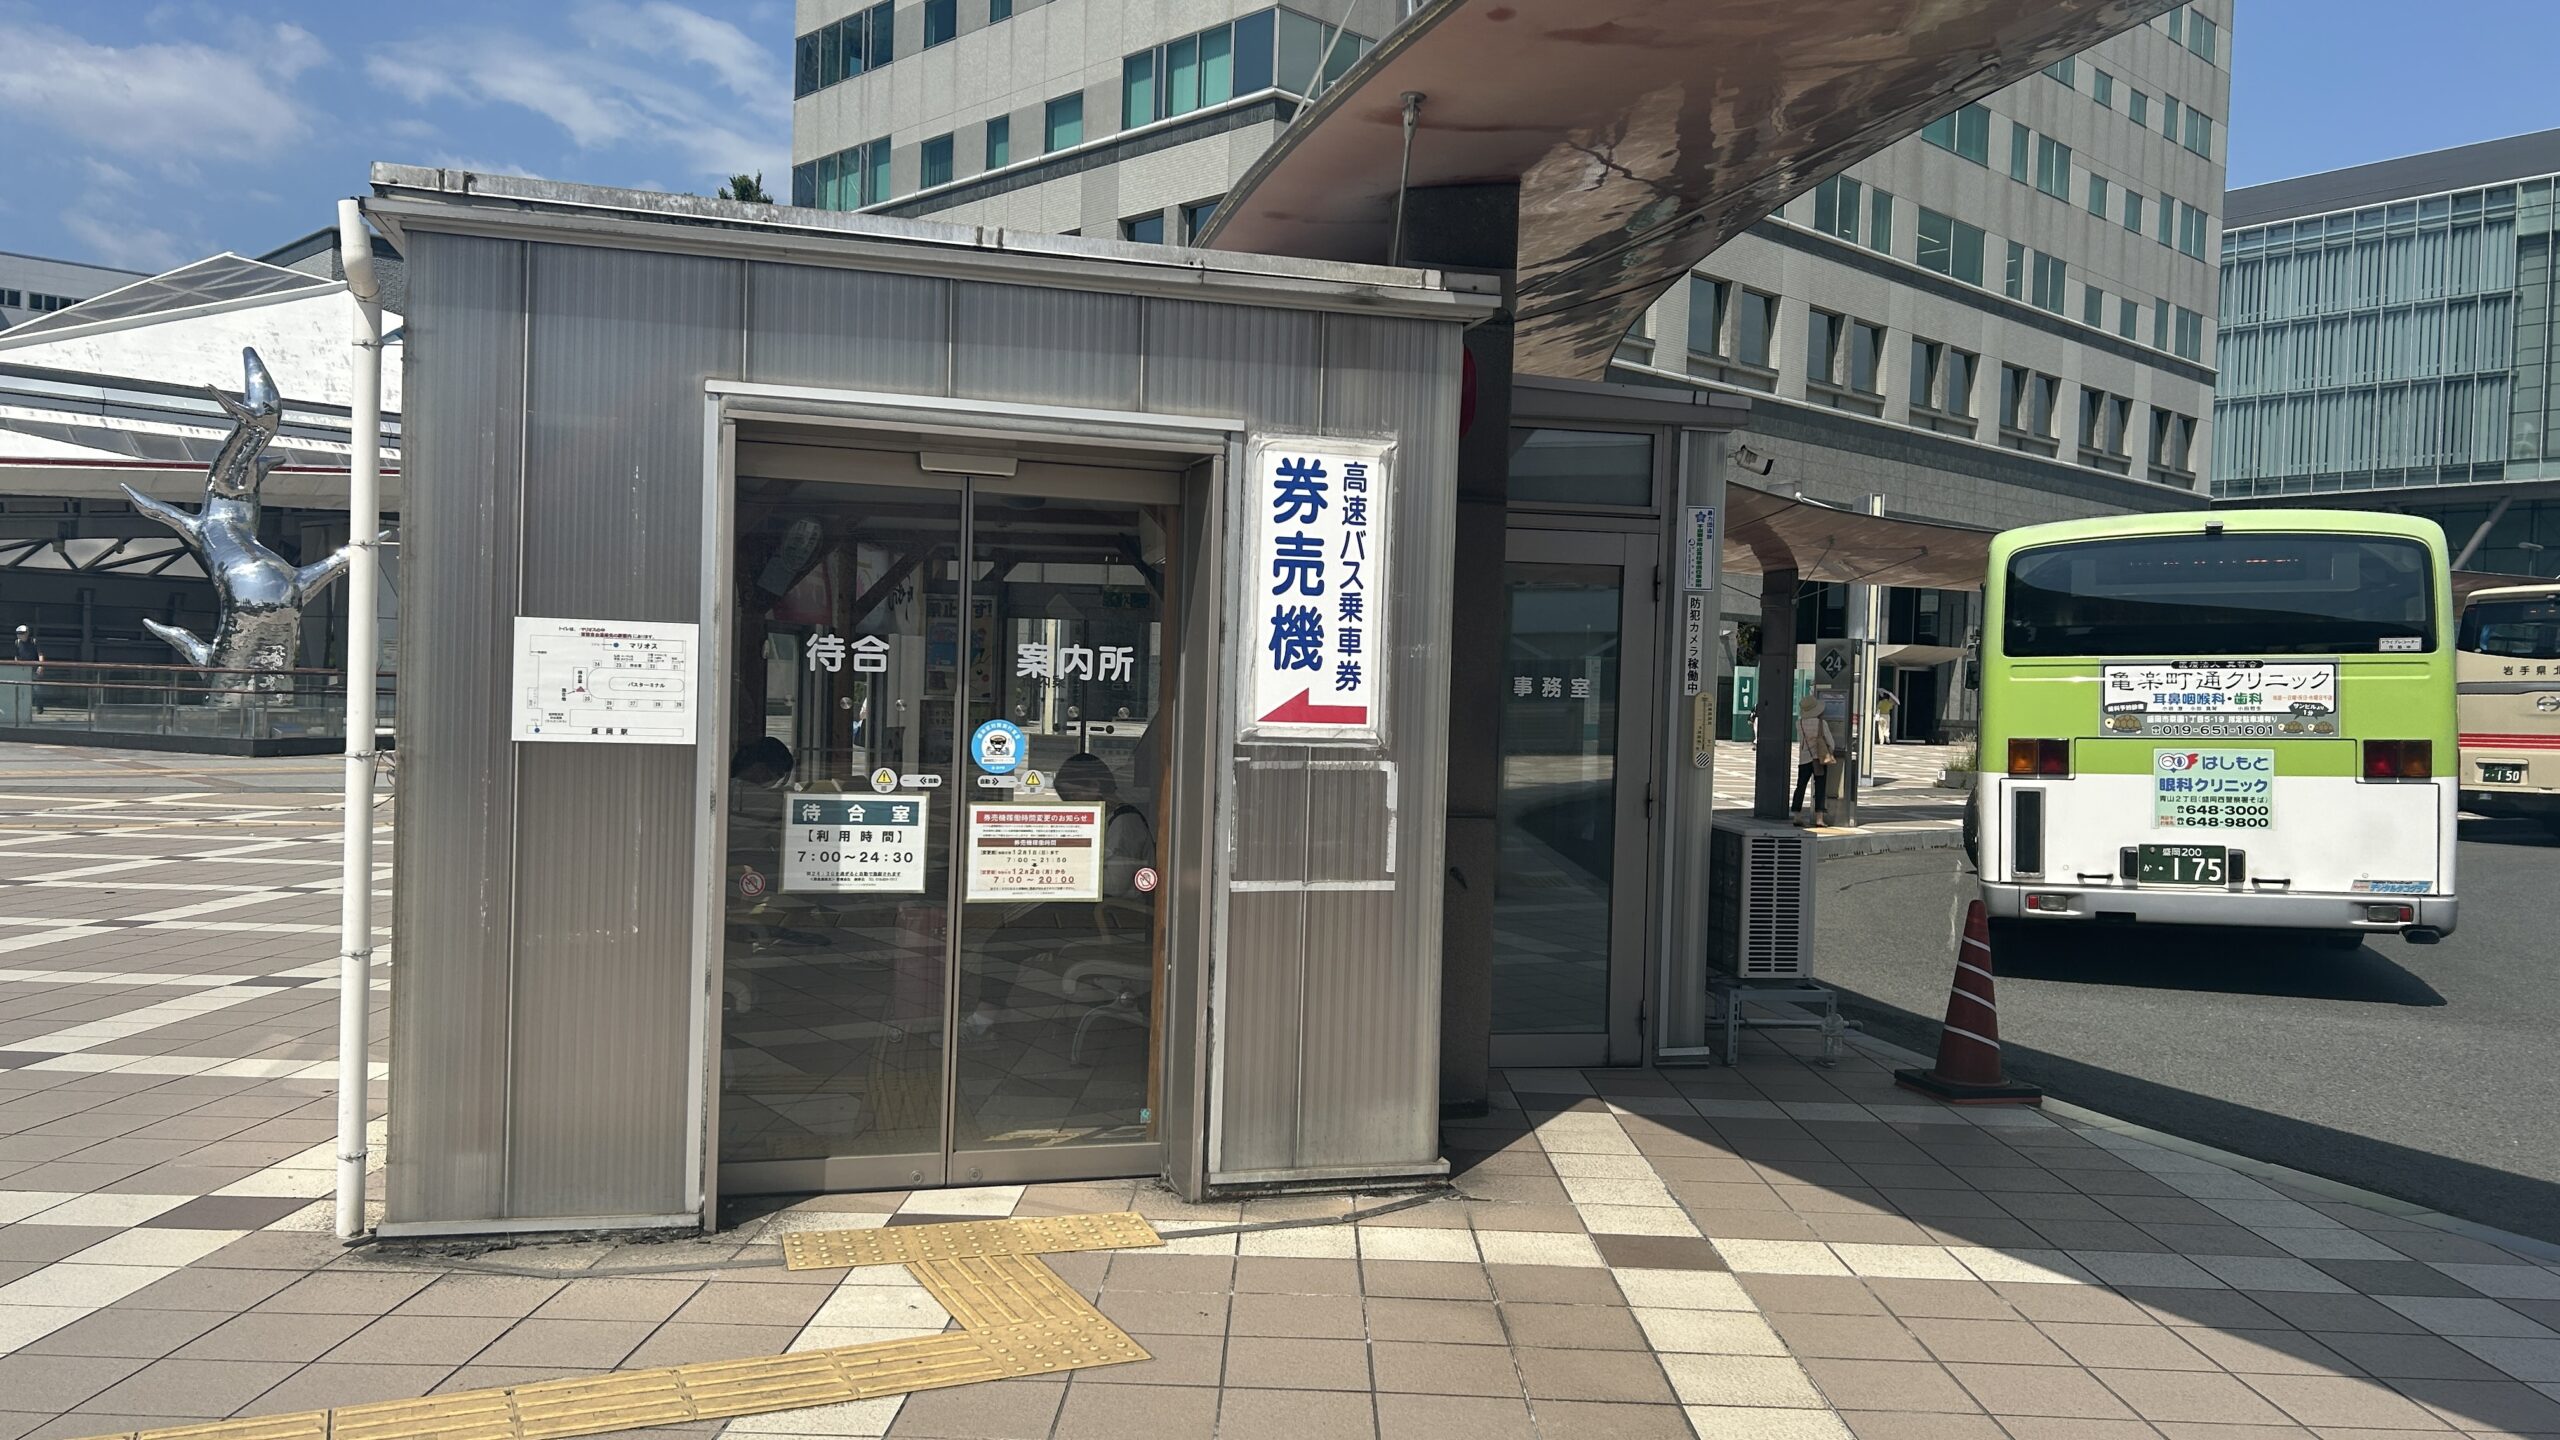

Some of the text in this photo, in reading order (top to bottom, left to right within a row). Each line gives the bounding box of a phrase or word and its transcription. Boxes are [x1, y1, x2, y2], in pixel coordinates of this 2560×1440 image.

[1269, 457, 1329, 671] 券売機
[1335, 461, 1368, 692] 高速バス乗車券
[1687, 597, 1701, 694] 防犯カメラ稼働中
[806, 634, 1135, 682] 待合 案内所
[1826, 656, 1842, 672] 24
[1513, 676, 1591, 698] 事務室
[2162, 725, 2275, 736] 019-651-1601
[2202, 756, 2269, 771] はしもと
[2159, 778, 2268, 792] 眼科クリニック
[802, 803, 910, 823] 待合室
[2186, 805, 2269, 816] 648-3000
[2186, 817, 2269, 828] 648-9800
[808, 829, 903, 843] 【利用時間】
[2162, 848, 2202, 857] 盛岡200
